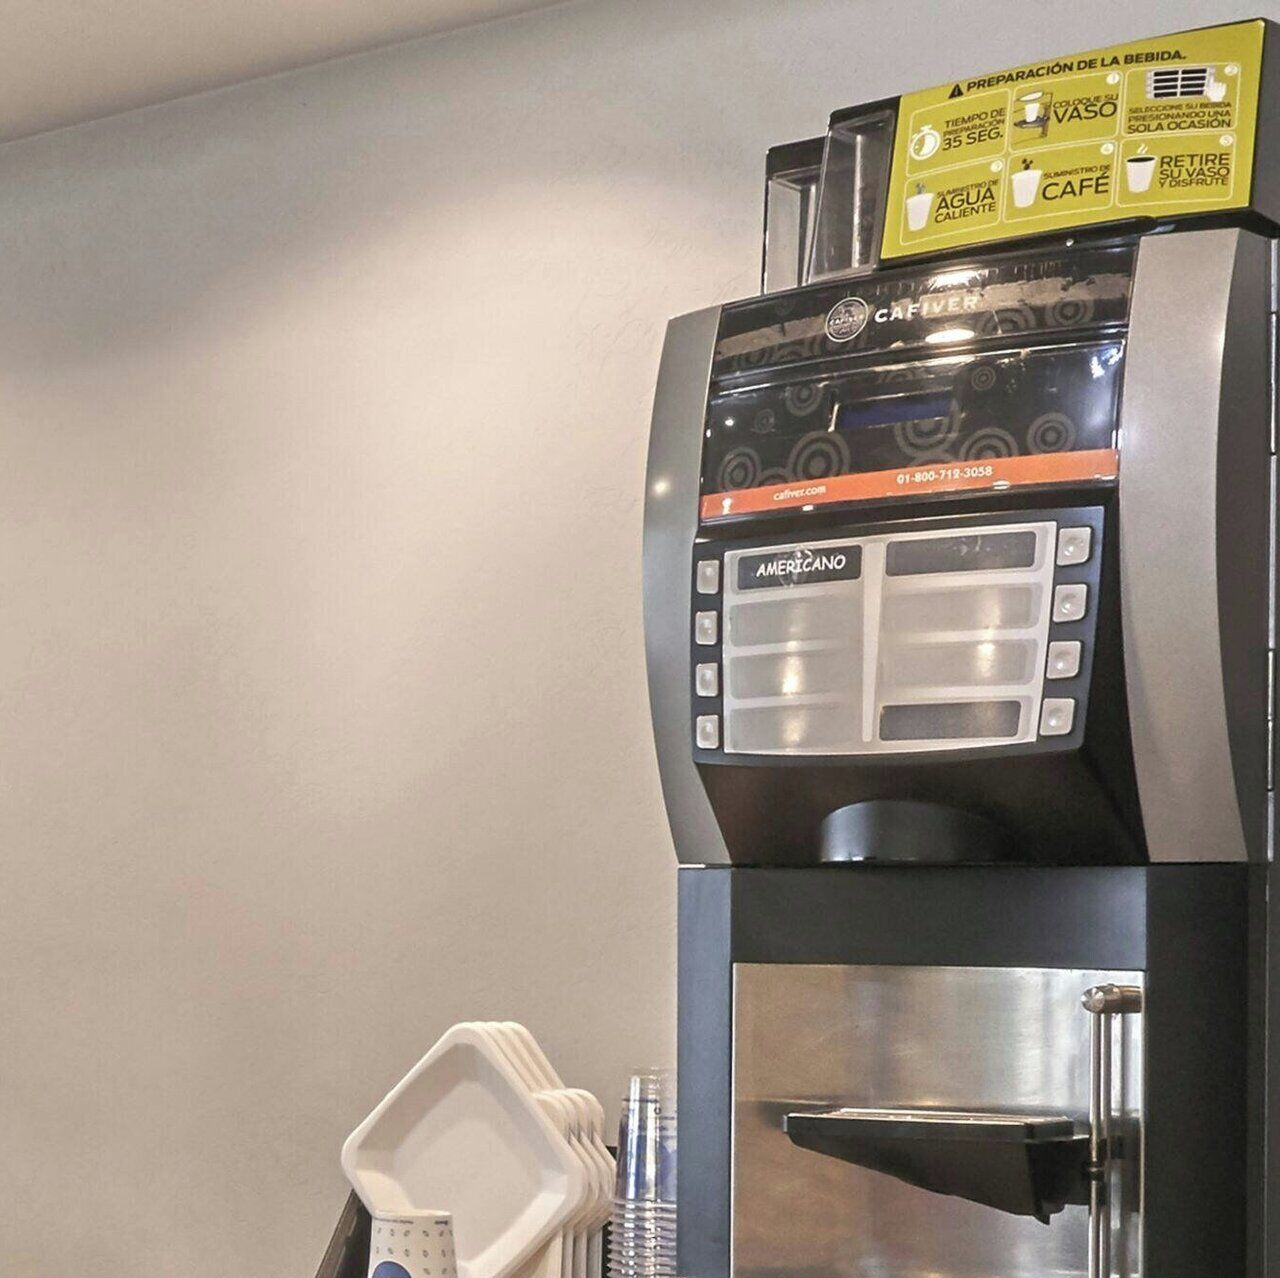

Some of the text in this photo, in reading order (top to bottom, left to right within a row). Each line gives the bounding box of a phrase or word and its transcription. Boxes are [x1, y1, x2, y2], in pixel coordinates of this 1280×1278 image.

[966, 50, 1188, 92] PREPARACIÓN DE LA BEBIDA.
[1052, 93, 1119, 109] COLOQUE SU
[1185, 102, 1199, 110] SU
[944, 107, 1006, 129] TIEMPO DE
[1053, 101, 1119, 124] VASO
[1128, 109, 1231, 123] PRESIONANDO UNA
[1127, 115, 1232, 135] SOLA OCASIÓN
[942, 127, 1004, 151] 35 SEG.
[1098, 164, 1111, 173] DE
[1160, 152, 1231, 169] RETIRE
[989, 179, 1000, 187] DE
[1159, 166, 1231, 180] SU VASO
[1159, 176, 1229, 188] Y DISFRUTE
[1042, 171, 1110, 201] CAFÉ
[935, 187, 995, 213] AGUA
[934, 201, 996, 224] CALIENTE
[874, 295, 979, 323] CAFIVER
[773, 484, 827, 501] cafiver.com
[755, 554, 846, 578] AMERICANO
